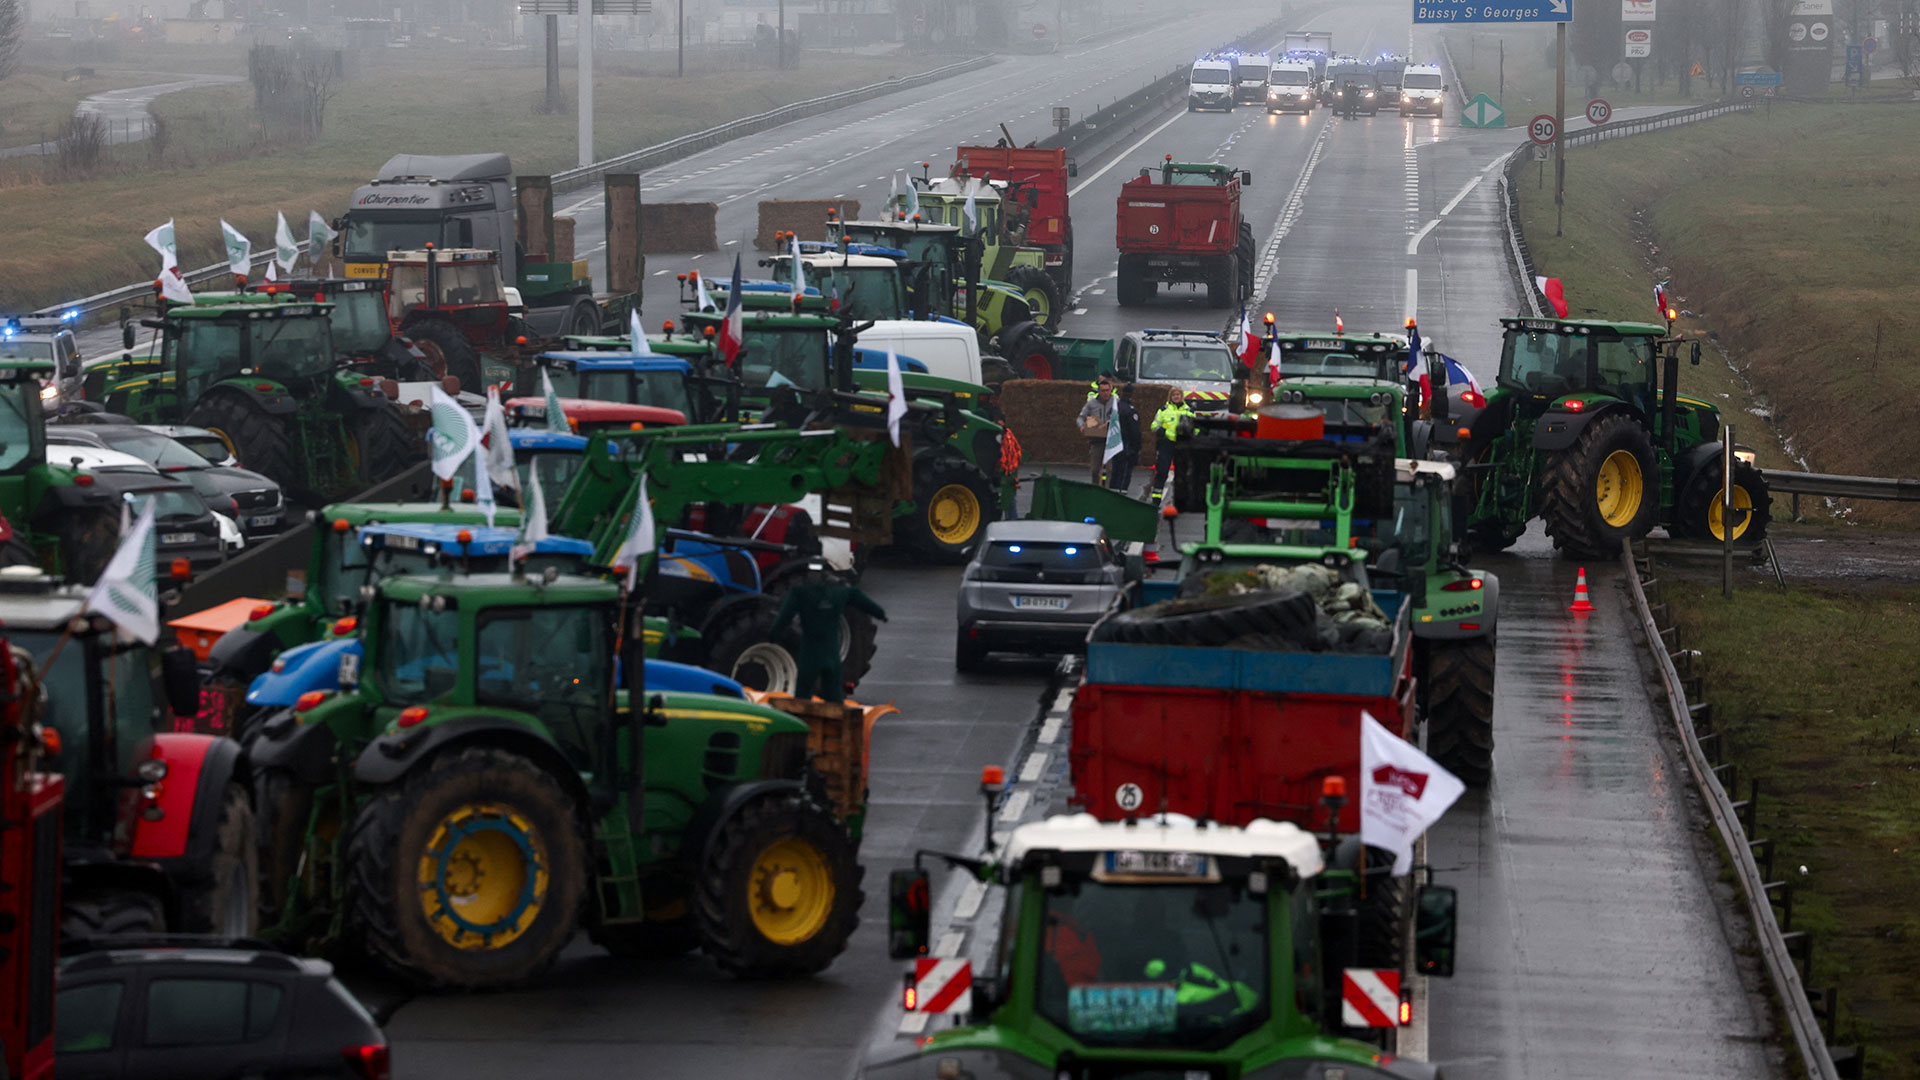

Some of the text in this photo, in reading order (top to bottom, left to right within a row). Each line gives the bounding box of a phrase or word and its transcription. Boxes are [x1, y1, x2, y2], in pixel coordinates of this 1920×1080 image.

[1418, 6, 1539, 20] Bussy St Georges
[1592, 105, 1607, 117] 70
[1534, 123, 1553, 136] 90
[365, 193, 430, 206] Charpentier
